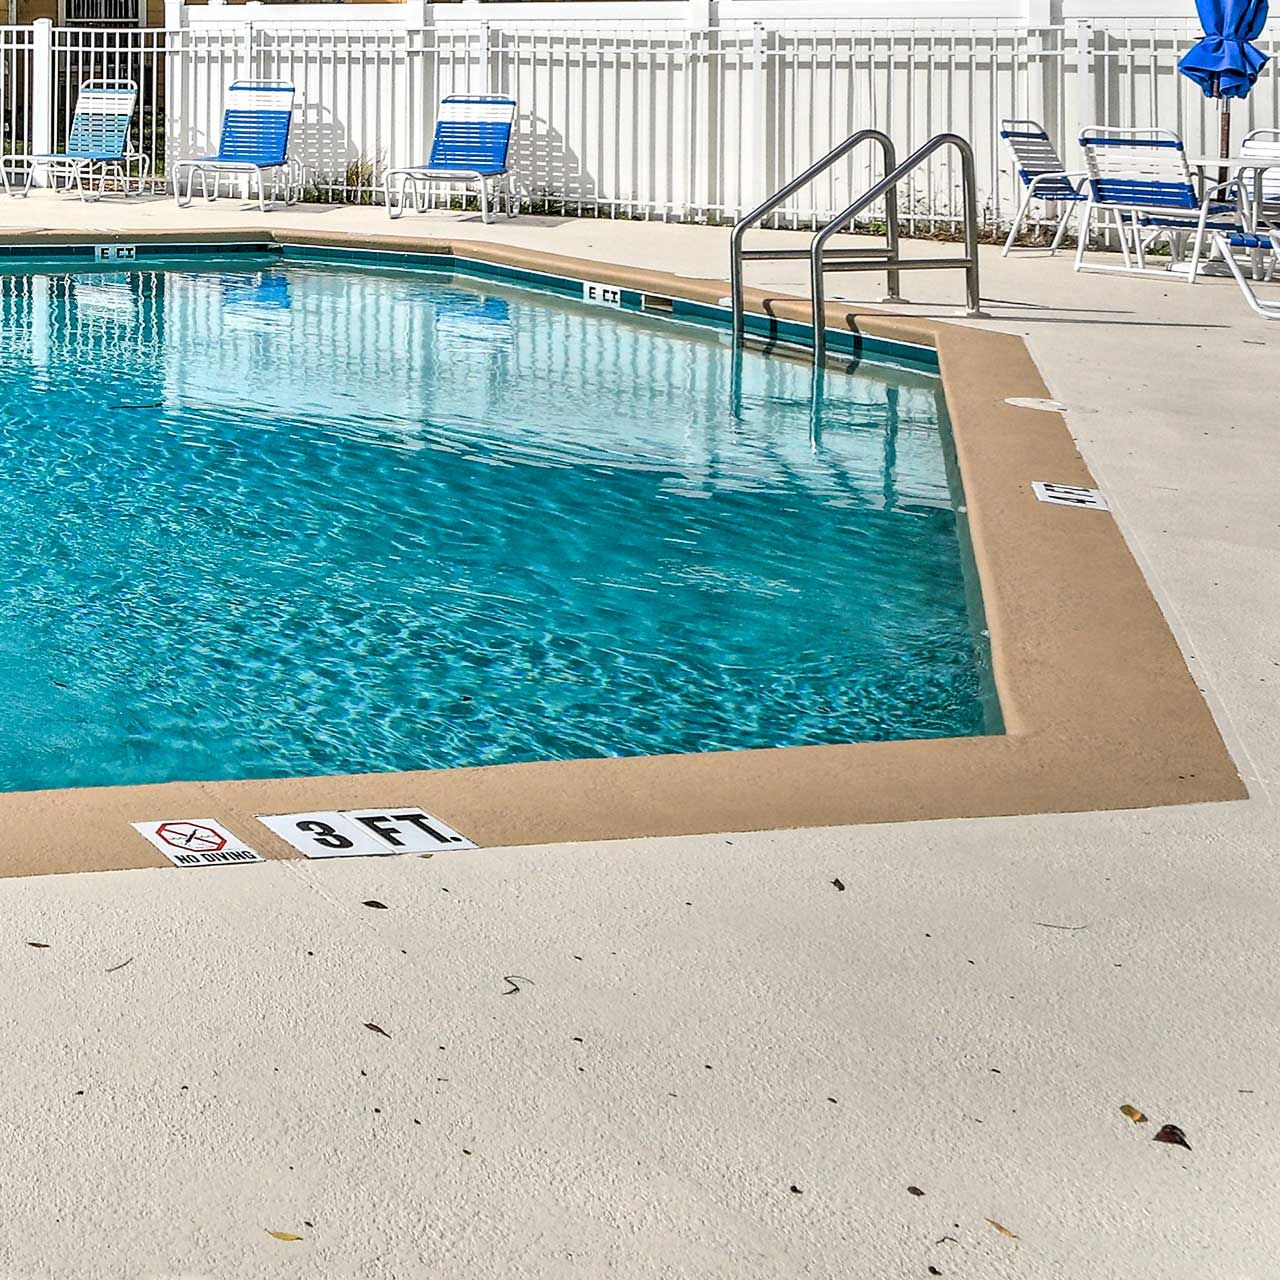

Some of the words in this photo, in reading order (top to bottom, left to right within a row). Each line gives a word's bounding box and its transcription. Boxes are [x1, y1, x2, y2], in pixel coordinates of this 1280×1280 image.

[296, 821, 354, 848] 3
[355, 813, 463, 846] FT.
[174, 854, 200, 864] NO
[200, 851, 257, 862] DIVING
